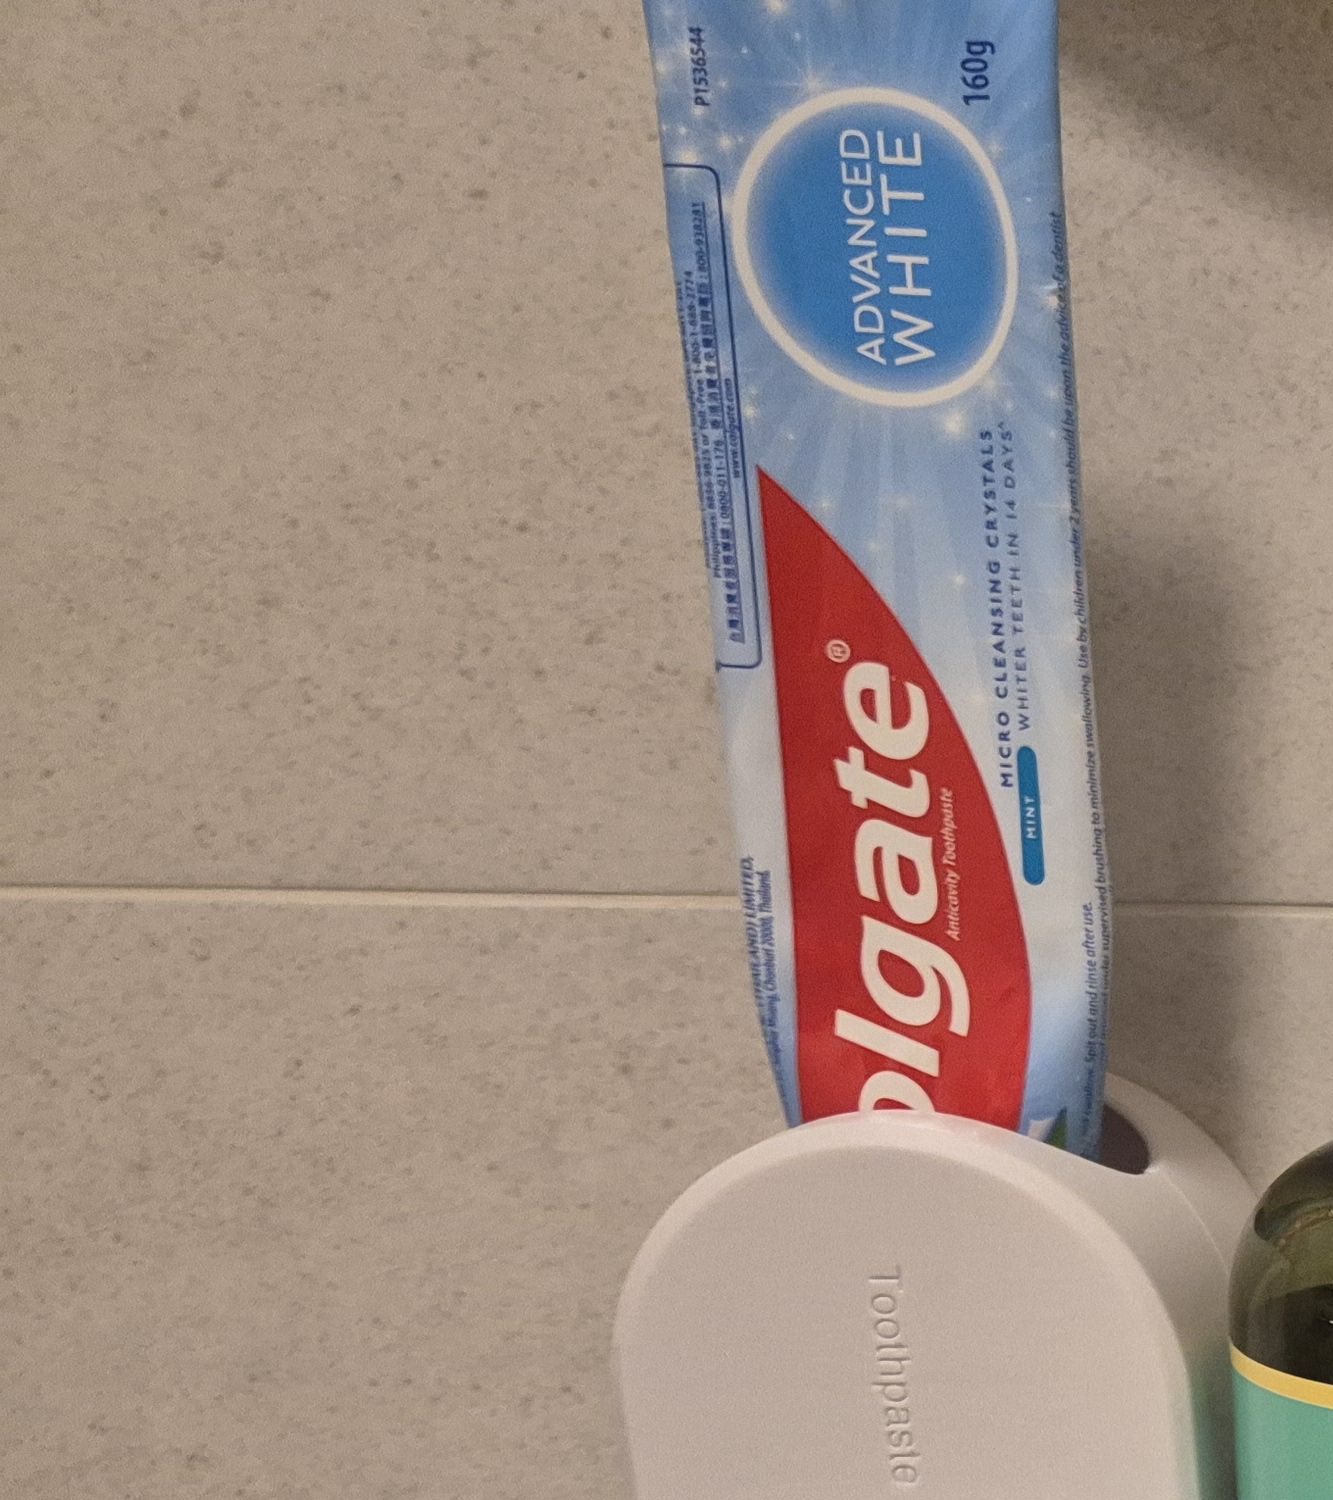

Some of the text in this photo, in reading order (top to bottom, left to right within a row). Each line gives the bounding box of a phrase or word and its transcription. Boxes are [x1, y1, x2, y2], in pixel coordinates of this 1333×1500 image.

[962, 39, 996, 106] 160g
[839, 128, 887, 365] ADVANCED
[877, 130, 937, 366] WHITE
[1048, 211, 1064, 263] dentist
[1055, 295, 1070, 341] advice
[1058, 344, 1071, 367] the
[1061, 369, 1075, 406] upon
[1062, 409, 1074, 426] be
[1062, 428, 1077, 476] should
[1003, 500, 1017, 519] 14
[1067, 477, 1082, 515] years
[1069, 515, 1080, 525] 2
[1006, 533, 1020, 556] IN
[1069, 527, 1083, 568] under
[980, 429, 1014, 787] MICRO CLEANSING CRYSTALS
[1008, 567, 1025, 635] TEETH
[1072, 569, 1087, 625] children
[1076, 626, 1089, 643] by
[1077, 645, 1089, 669] Use
[1011, 645, 1030, 731] WHITER
[1086, 751, 1099, 809] minimize
[1023, 794, 1036, 840] MINT
[1091, 812, 1101, 826] to
[939, 786, 961, 942] Anticavity Toothpaste
[1092, 829, 1106, 884] brushing
[1082, 901, 1093, 926] use.
[1082, 926, 1095, 958] after
[1083, 960, 1096, 990] rinse
[1085, 992, 1097, 1017] and
[1086, 1018, 1097, 1040] out
[1084, 1041, 1098, 1064] Spit
[868, 1264, 922, 1488] Toothpaste
